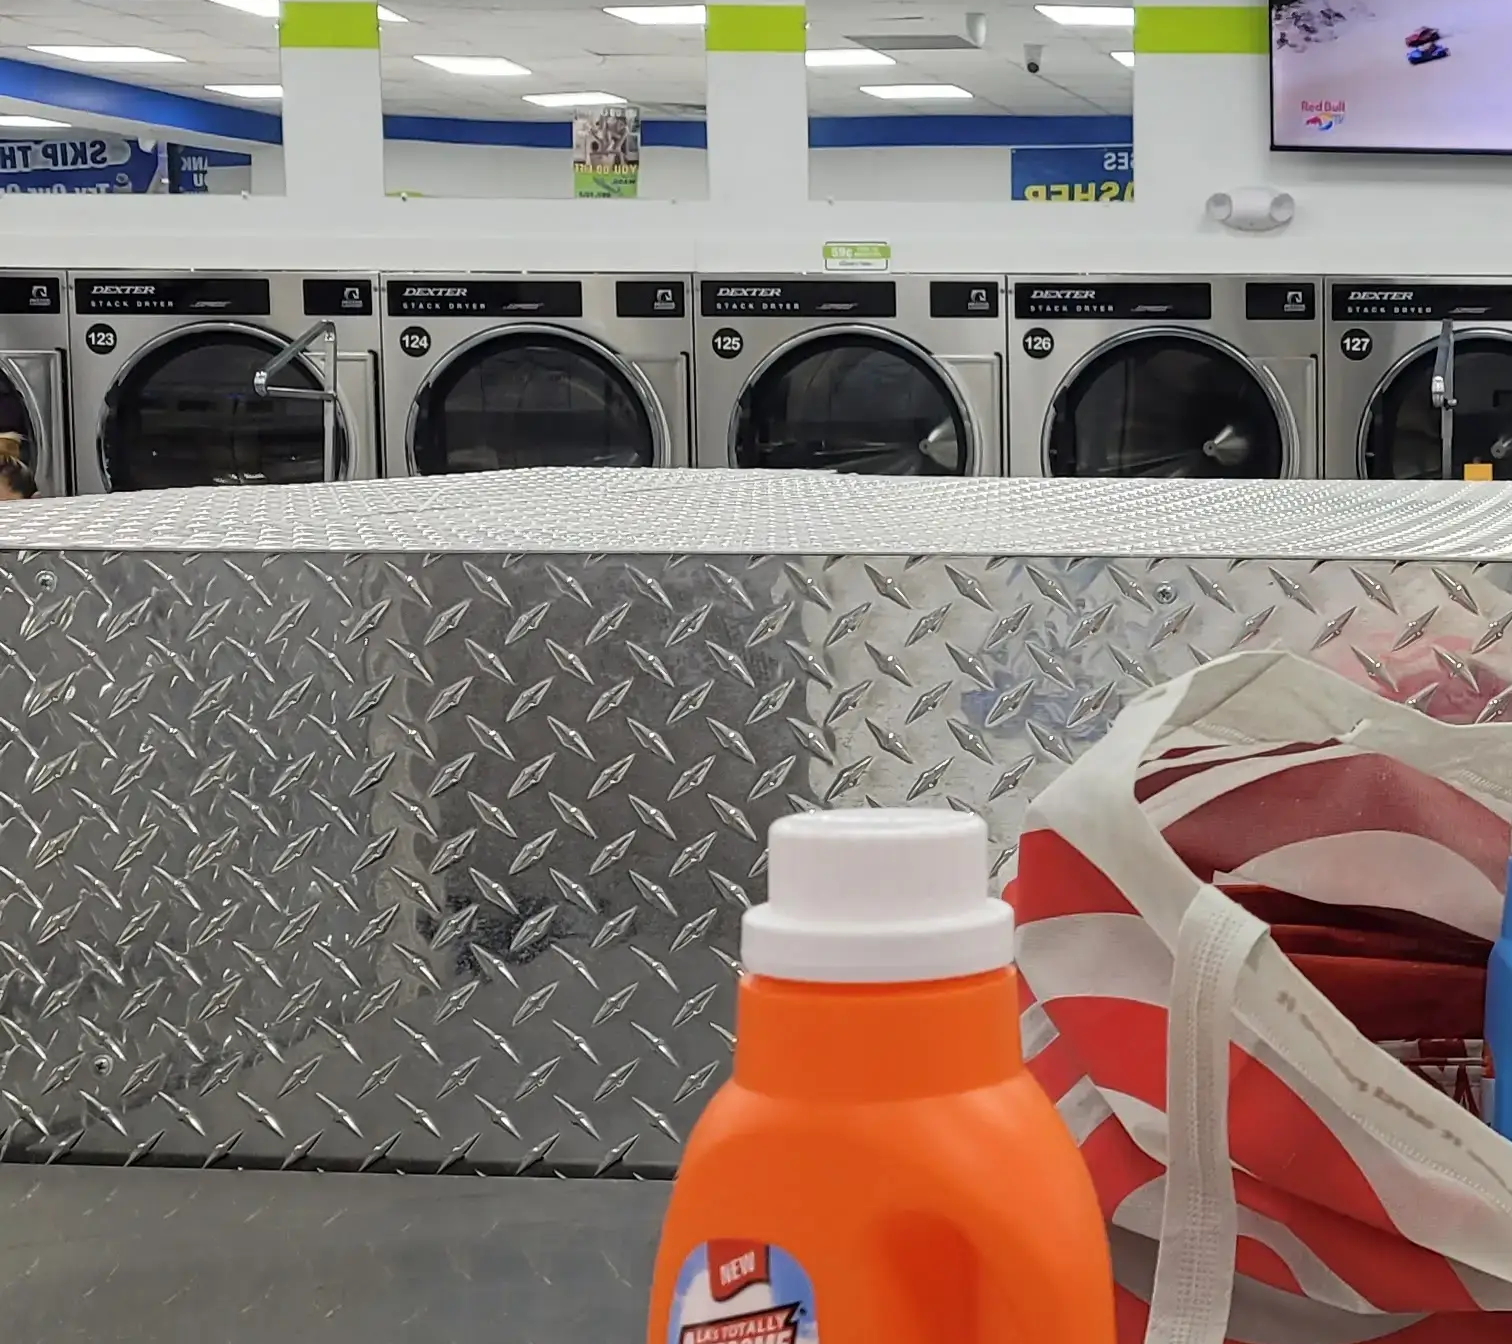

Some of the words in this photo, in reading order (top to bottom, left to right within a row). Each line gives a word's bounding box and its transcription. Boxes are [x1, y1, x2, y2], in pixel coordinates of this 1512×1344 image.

[91, 286, 156, 295] DEXTER
[402, 287, 468, 297] DEXTER
[716, 287, 782, 297] DEXTER
[1030, 289, 1096, 299] DEXTER
[1347, 291, 1414, 301] DEXTER
[88, 332, 115, 346] 123
[402, 335, 429, 349] 124
[714, 336, 741, 350] 125
[1024, 337, 1051, 351] 126
[1342, 337, 1371, 351] 127
[720, 1251, 756, 1286] NEW
[722, 1314, 786, 1339] TOTALLY
